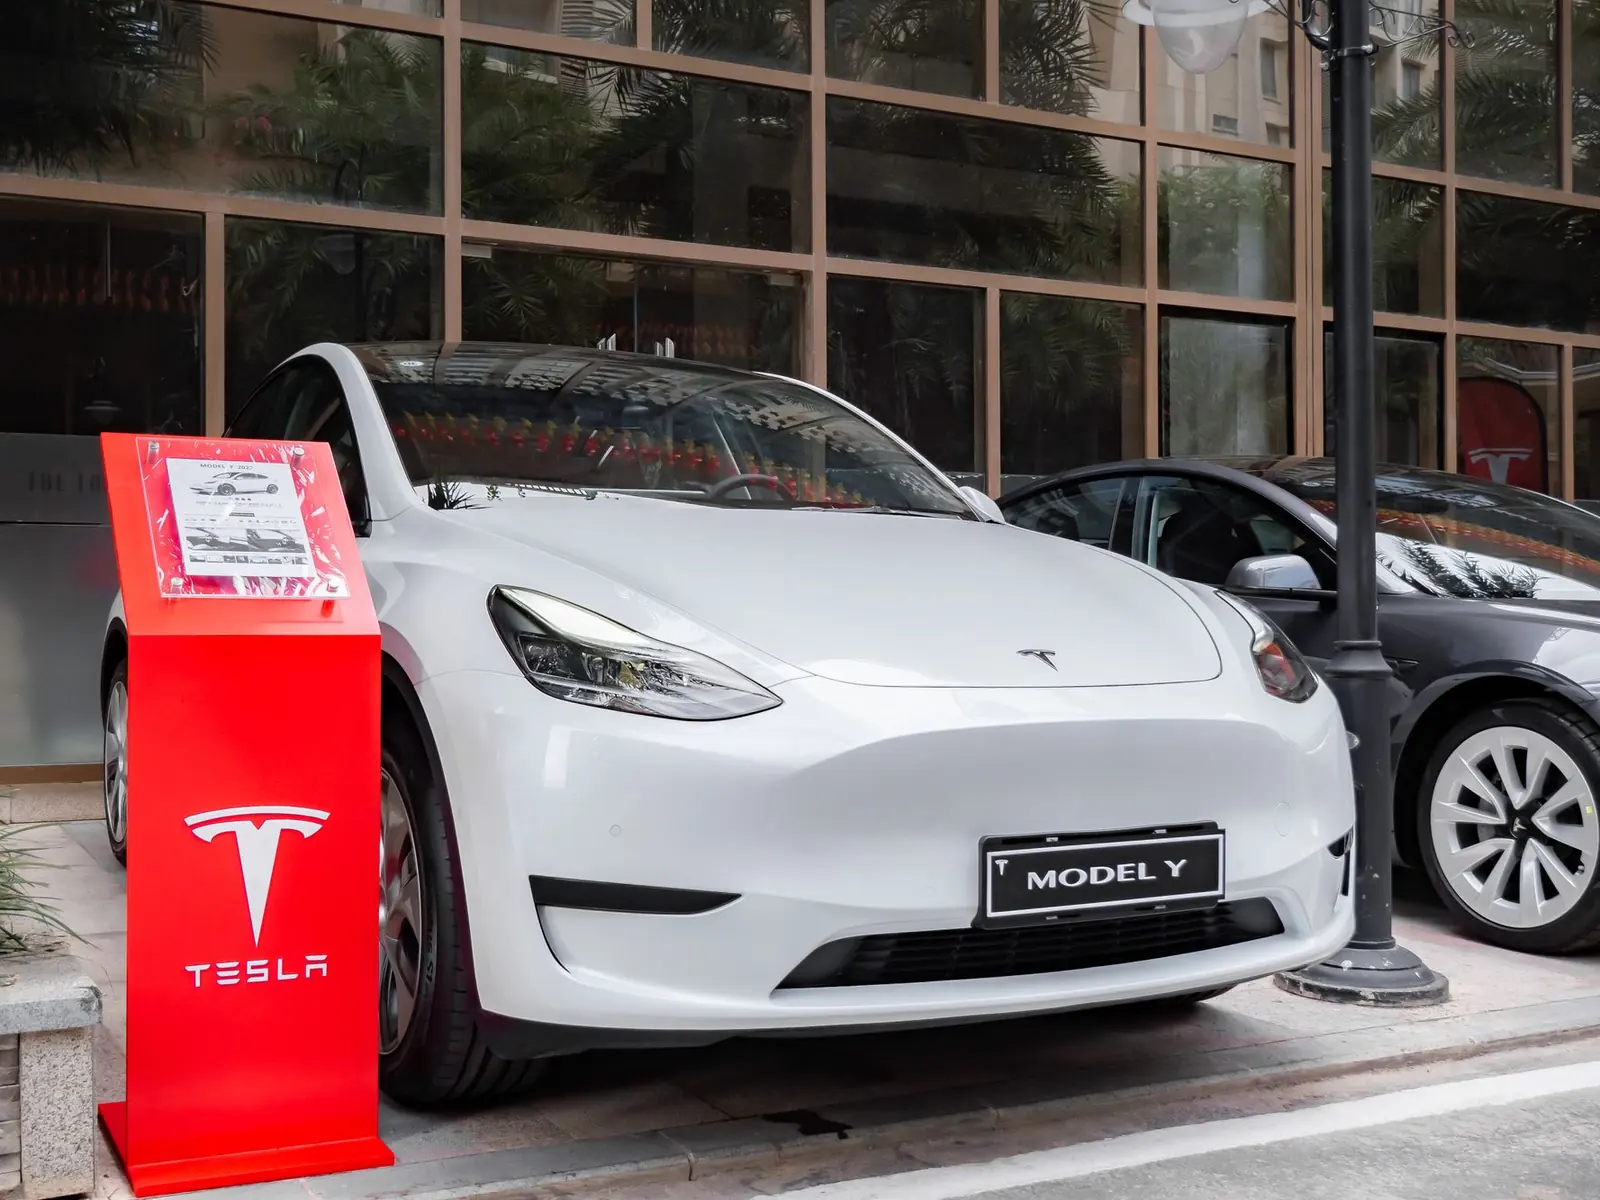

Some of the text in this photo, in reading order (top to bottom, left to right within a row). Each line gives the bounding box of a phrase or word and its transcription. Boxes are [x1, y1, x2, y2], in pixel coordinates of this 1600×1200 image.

[1027, 859, 1187, 890] MODEL Y
[184, 955, 328, 988] TESLA
